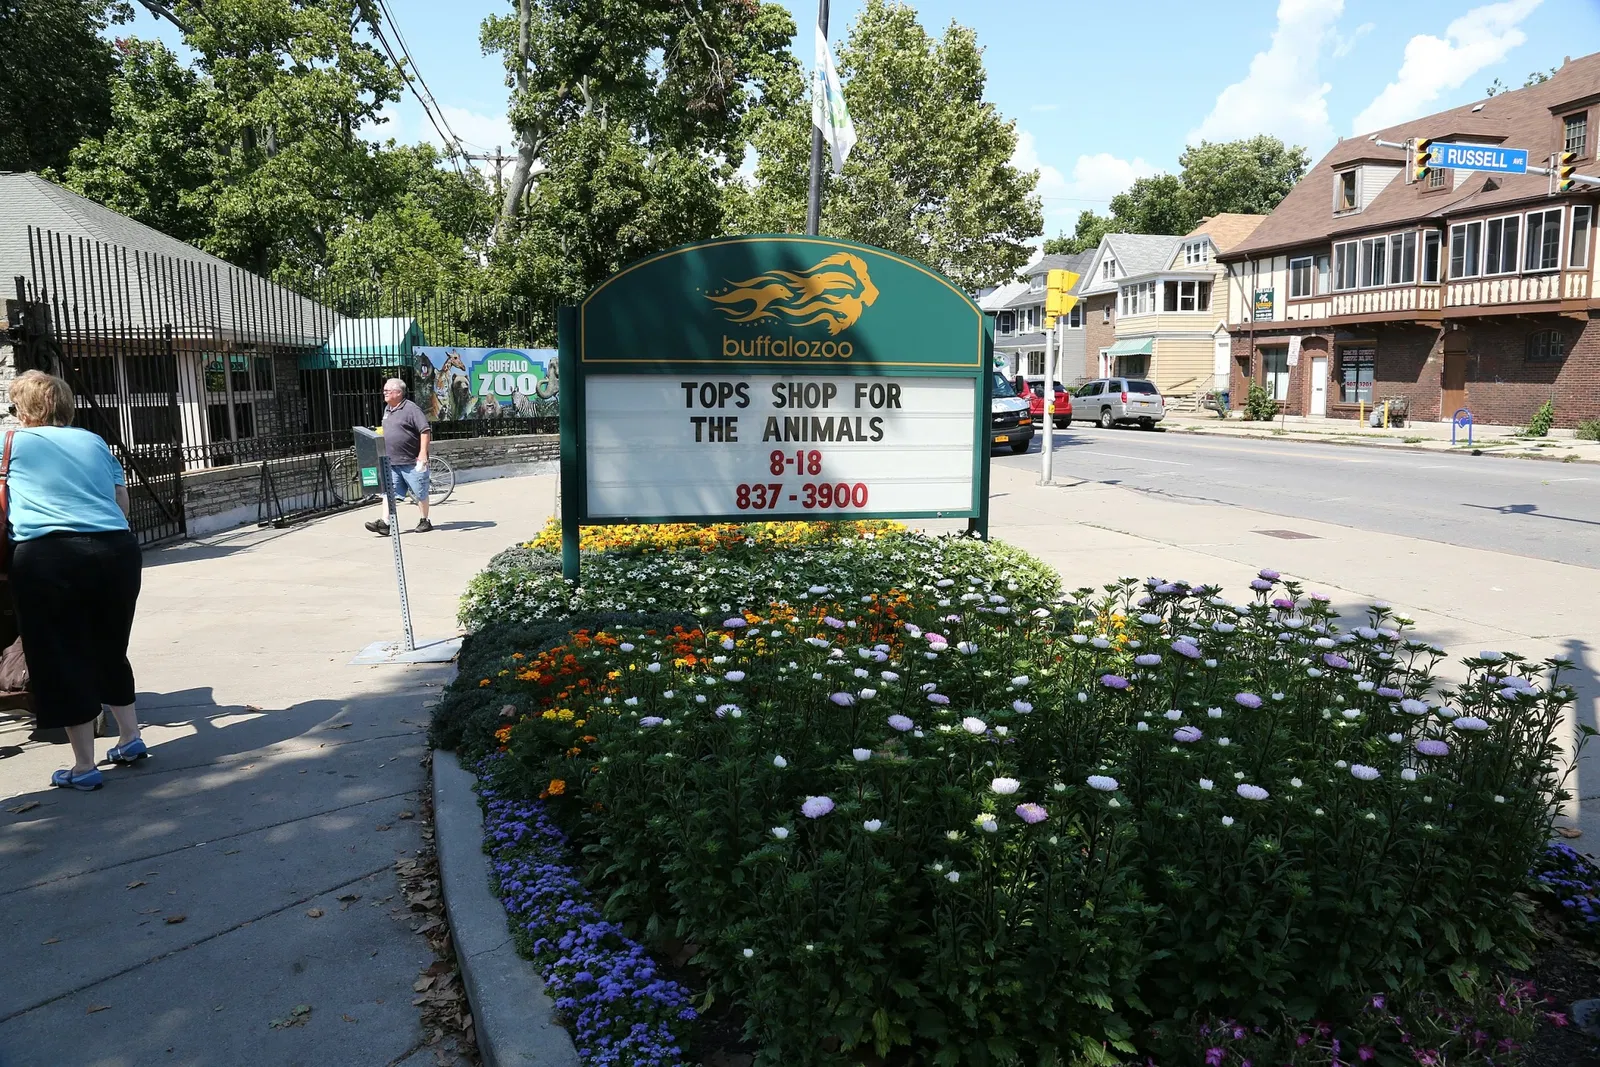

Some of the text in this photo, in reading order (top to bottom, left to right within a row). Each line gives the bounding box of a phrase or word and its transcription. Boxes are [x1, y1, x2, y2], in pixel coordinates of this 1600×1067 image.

[1447, 148, 1508, 168] RUSSELL
[722, 335, 853, 358] buffalozoo
[487, 360, 528, 373] BUFFALO
[478, 373, 538, 396] ZOO
[681, 382, 902, 409] TOPS SHOP FOR
[690, 416, 884, 443] THE ANIMALS
[770, 450, 822, 476] 8-18
